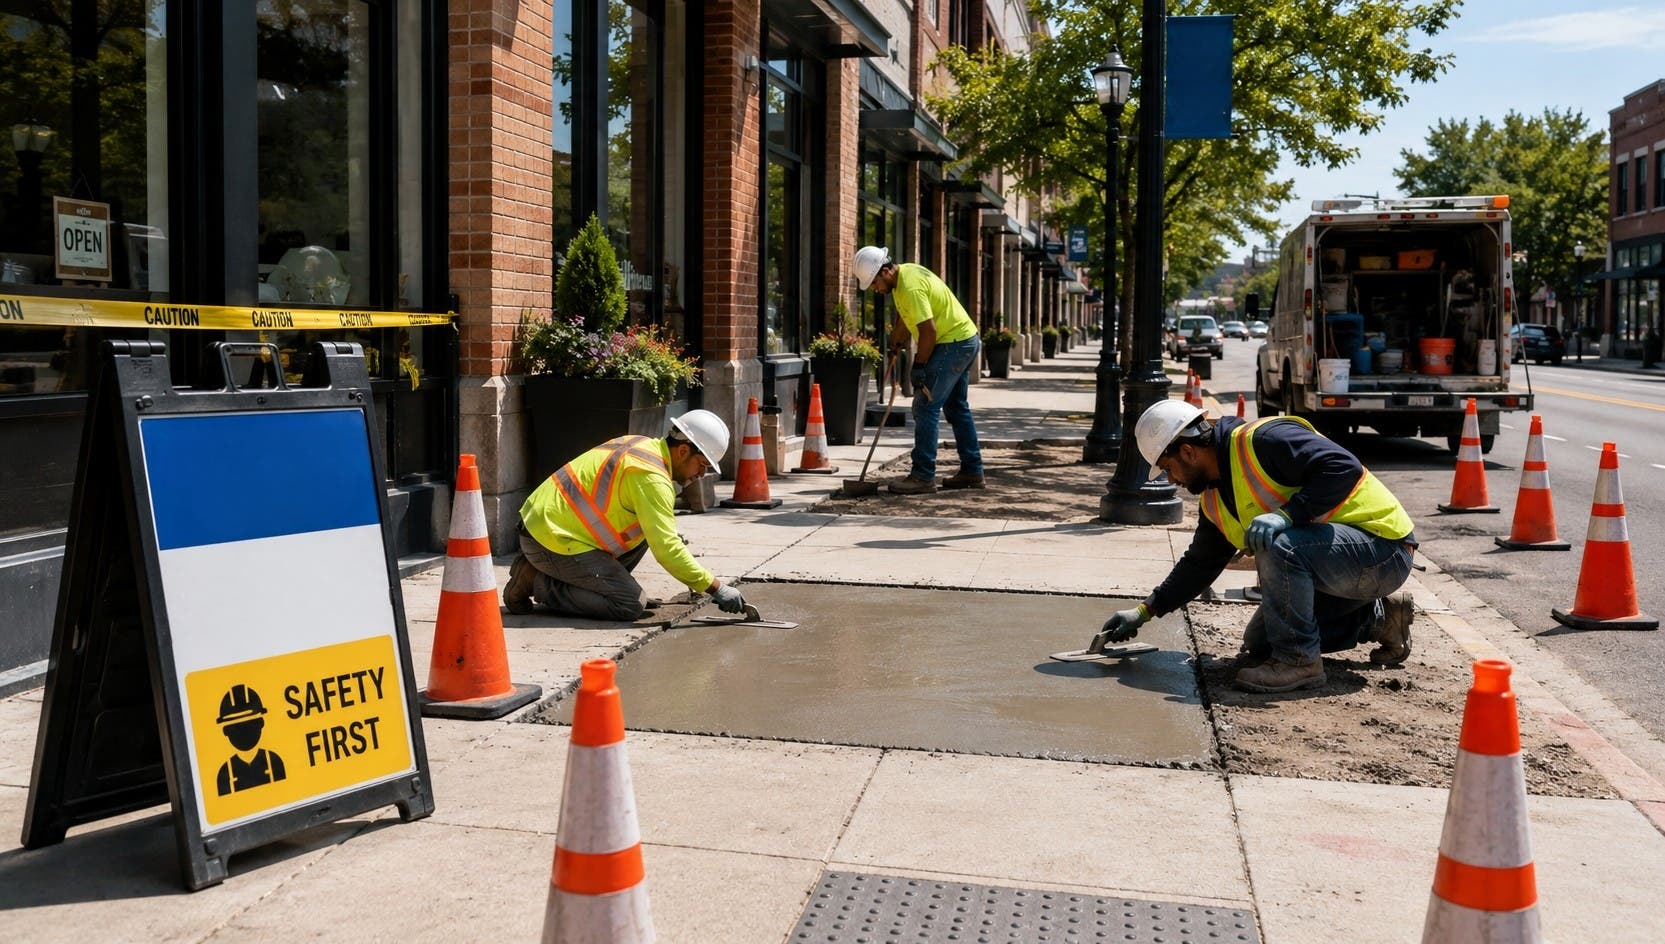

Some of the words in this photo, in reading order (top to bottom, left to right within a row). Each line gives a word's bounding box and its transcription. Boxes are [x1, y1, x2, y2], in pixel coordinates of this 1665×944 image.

[64, 227, 102, 254] OPEN
[144, 305, 200, 326] CAUTION
[251, 310, 294, 328] CAUTION
[284, 667, 385, 720] SAFETY
[305, 716, 380, 767] FIRST
